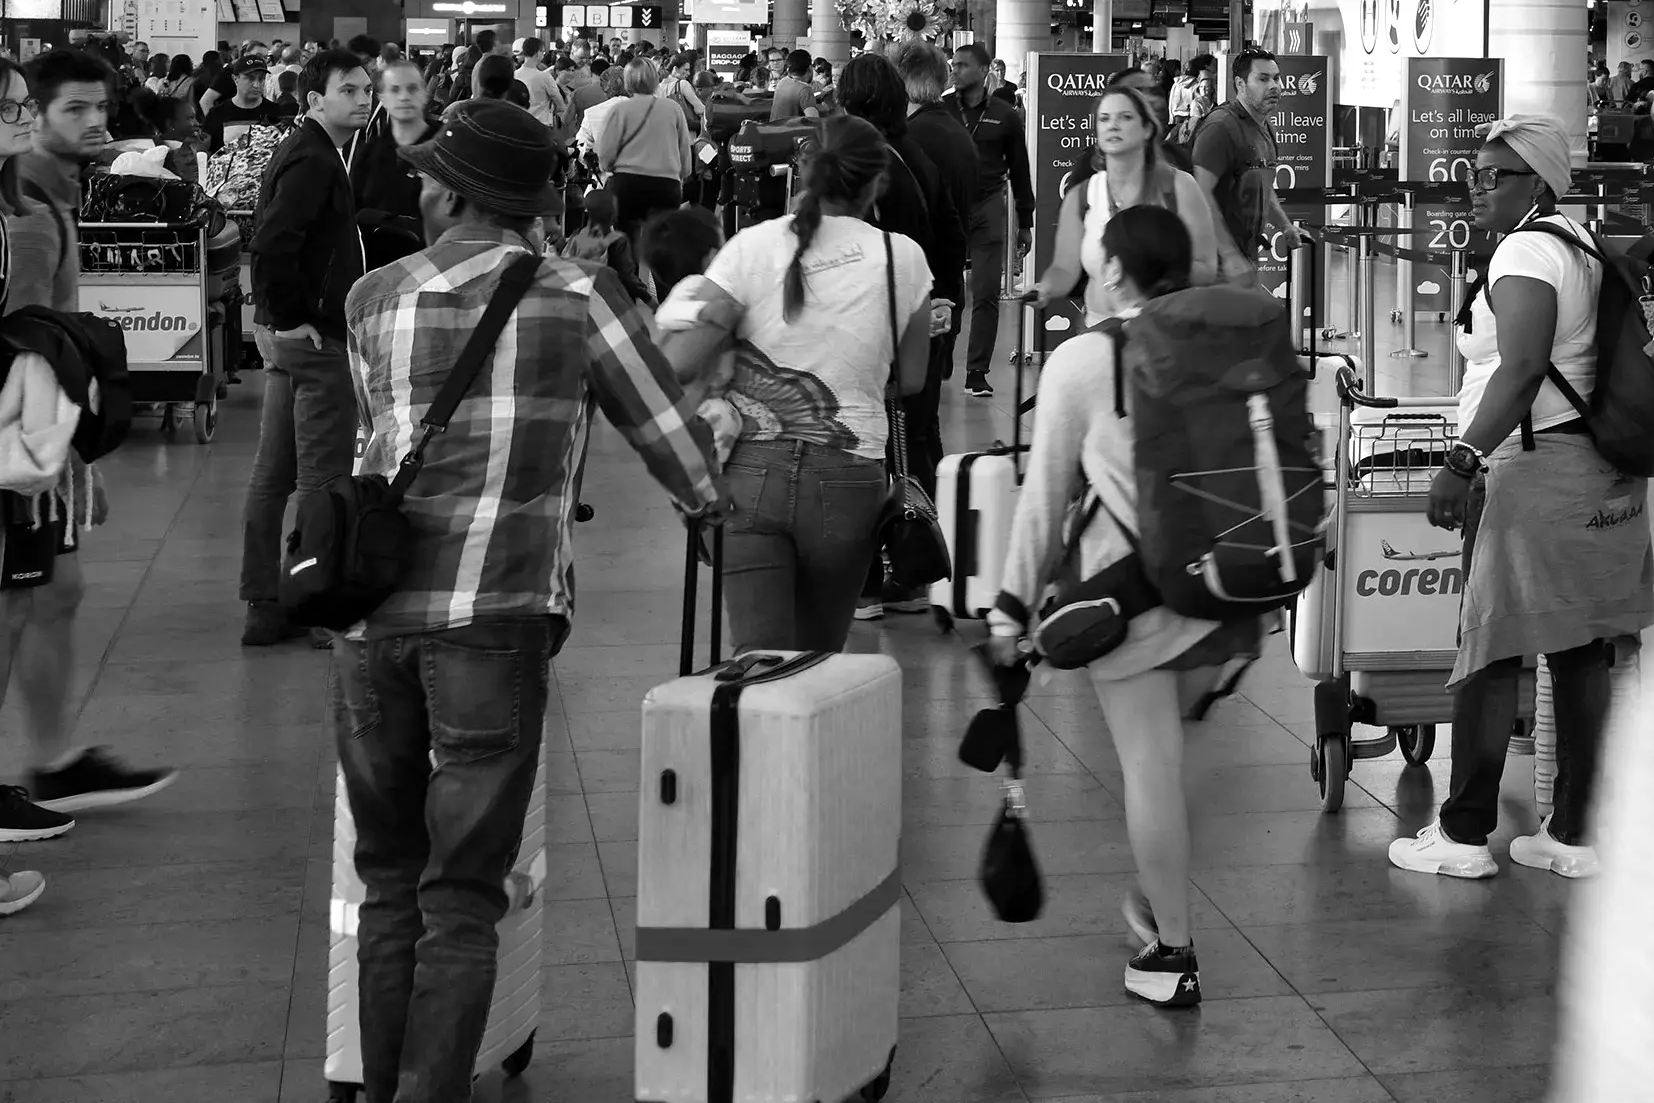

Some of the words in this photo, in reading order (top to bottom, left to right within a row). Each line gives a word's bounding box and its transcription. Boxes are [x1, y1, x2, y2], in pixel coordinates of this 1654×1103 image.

[569, 13, 578, 24] A
[593, 13, 602, 24] B
[617, 13, 625, 24] T
[1048, 74, 1105, 92] QATAR
[1418, 75, 1472, 92] QATAR
[1041, 114, 1075, 130] Let's
[1270, 113, 1284, 126] all
[1291, 112, 1323, 127] leave
[1412, 109, 1443, 123] Let's
[1448, 110, 1462, 123] all
[1468, 109, 1495, 123] leave
[1275, 130, 1307, 143] time
[1430, 129, 1448, 138] on
[1061, 137, 1080, 148] on
[1429, 158, 1471, 181] 60
[1429, 220, 1469, 248] 20
[1357, 568, 1463, 597] coren
